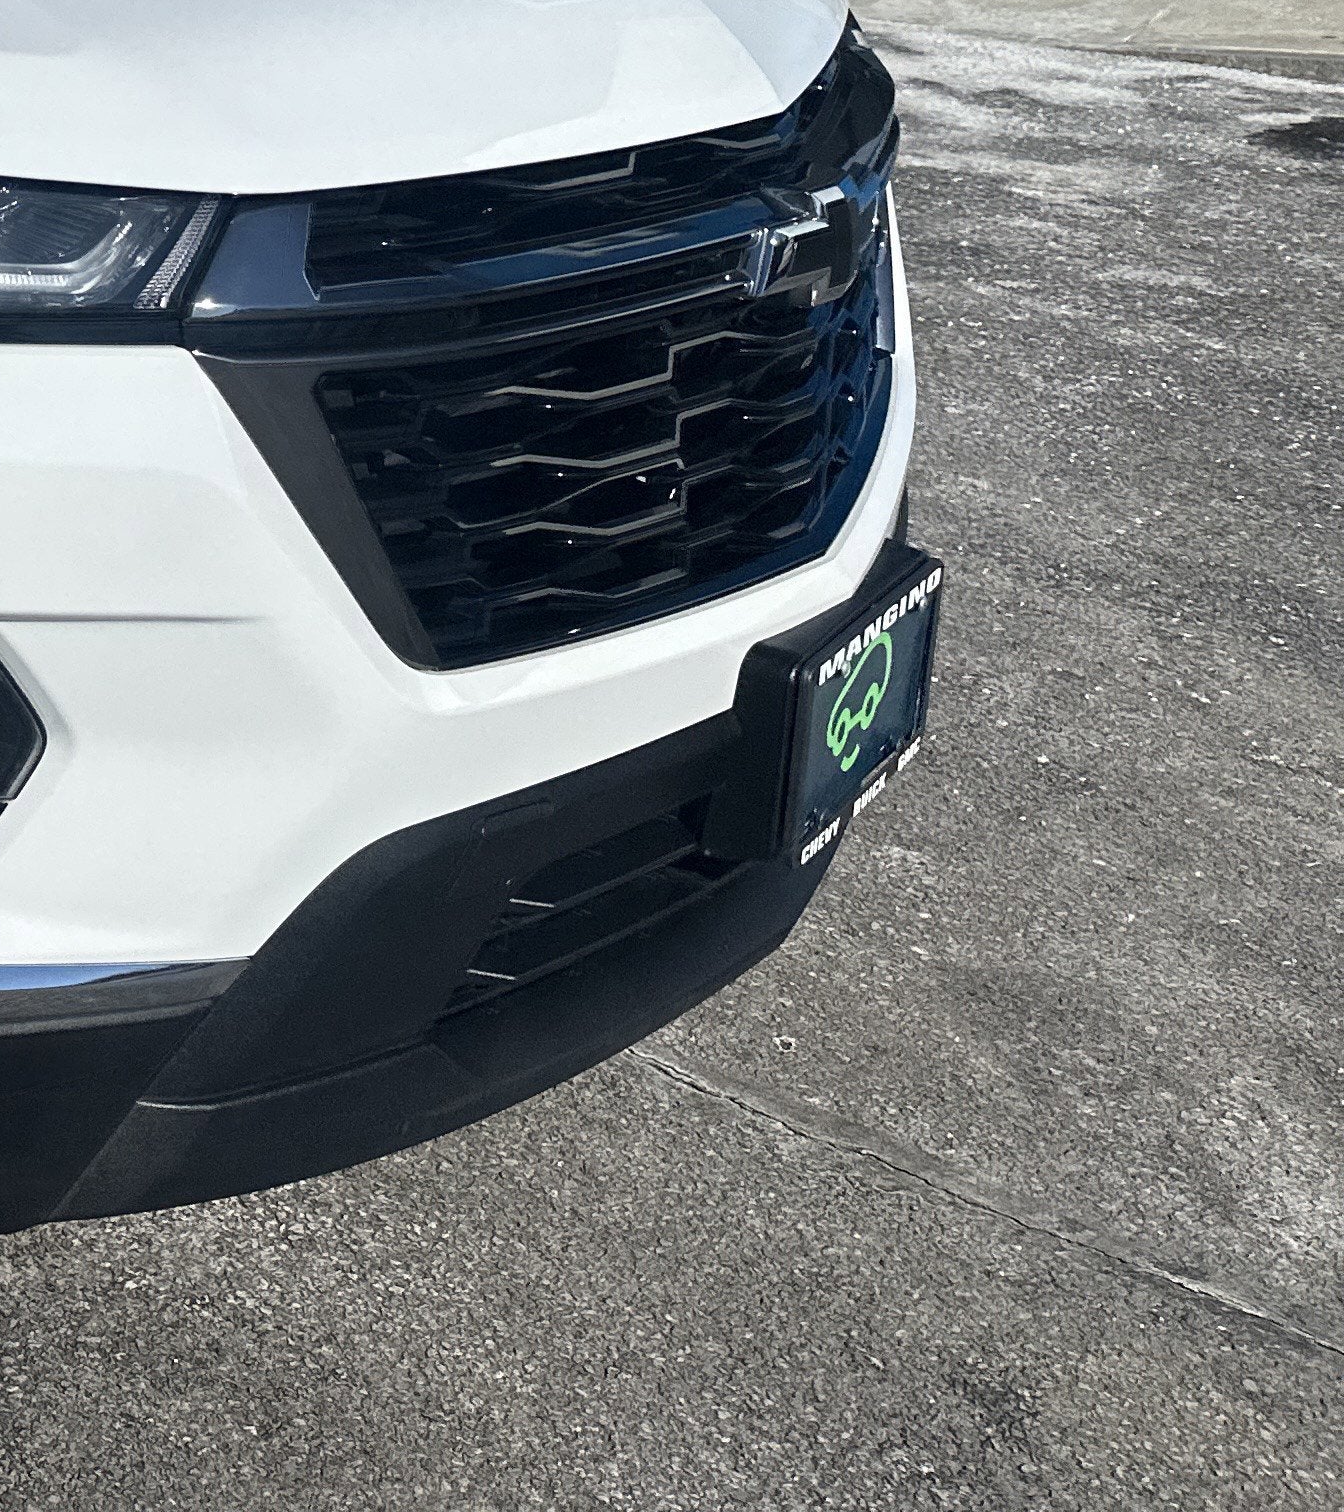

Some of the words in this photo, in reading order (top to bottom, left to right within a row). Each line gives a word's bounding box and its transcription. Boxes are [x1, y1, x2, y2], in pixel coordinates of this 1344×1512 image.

[818, 567, 943, 687] MANGINO
[800, 816, 841, 866] CHEVY
[852, 771, 887, 818] BUICK
